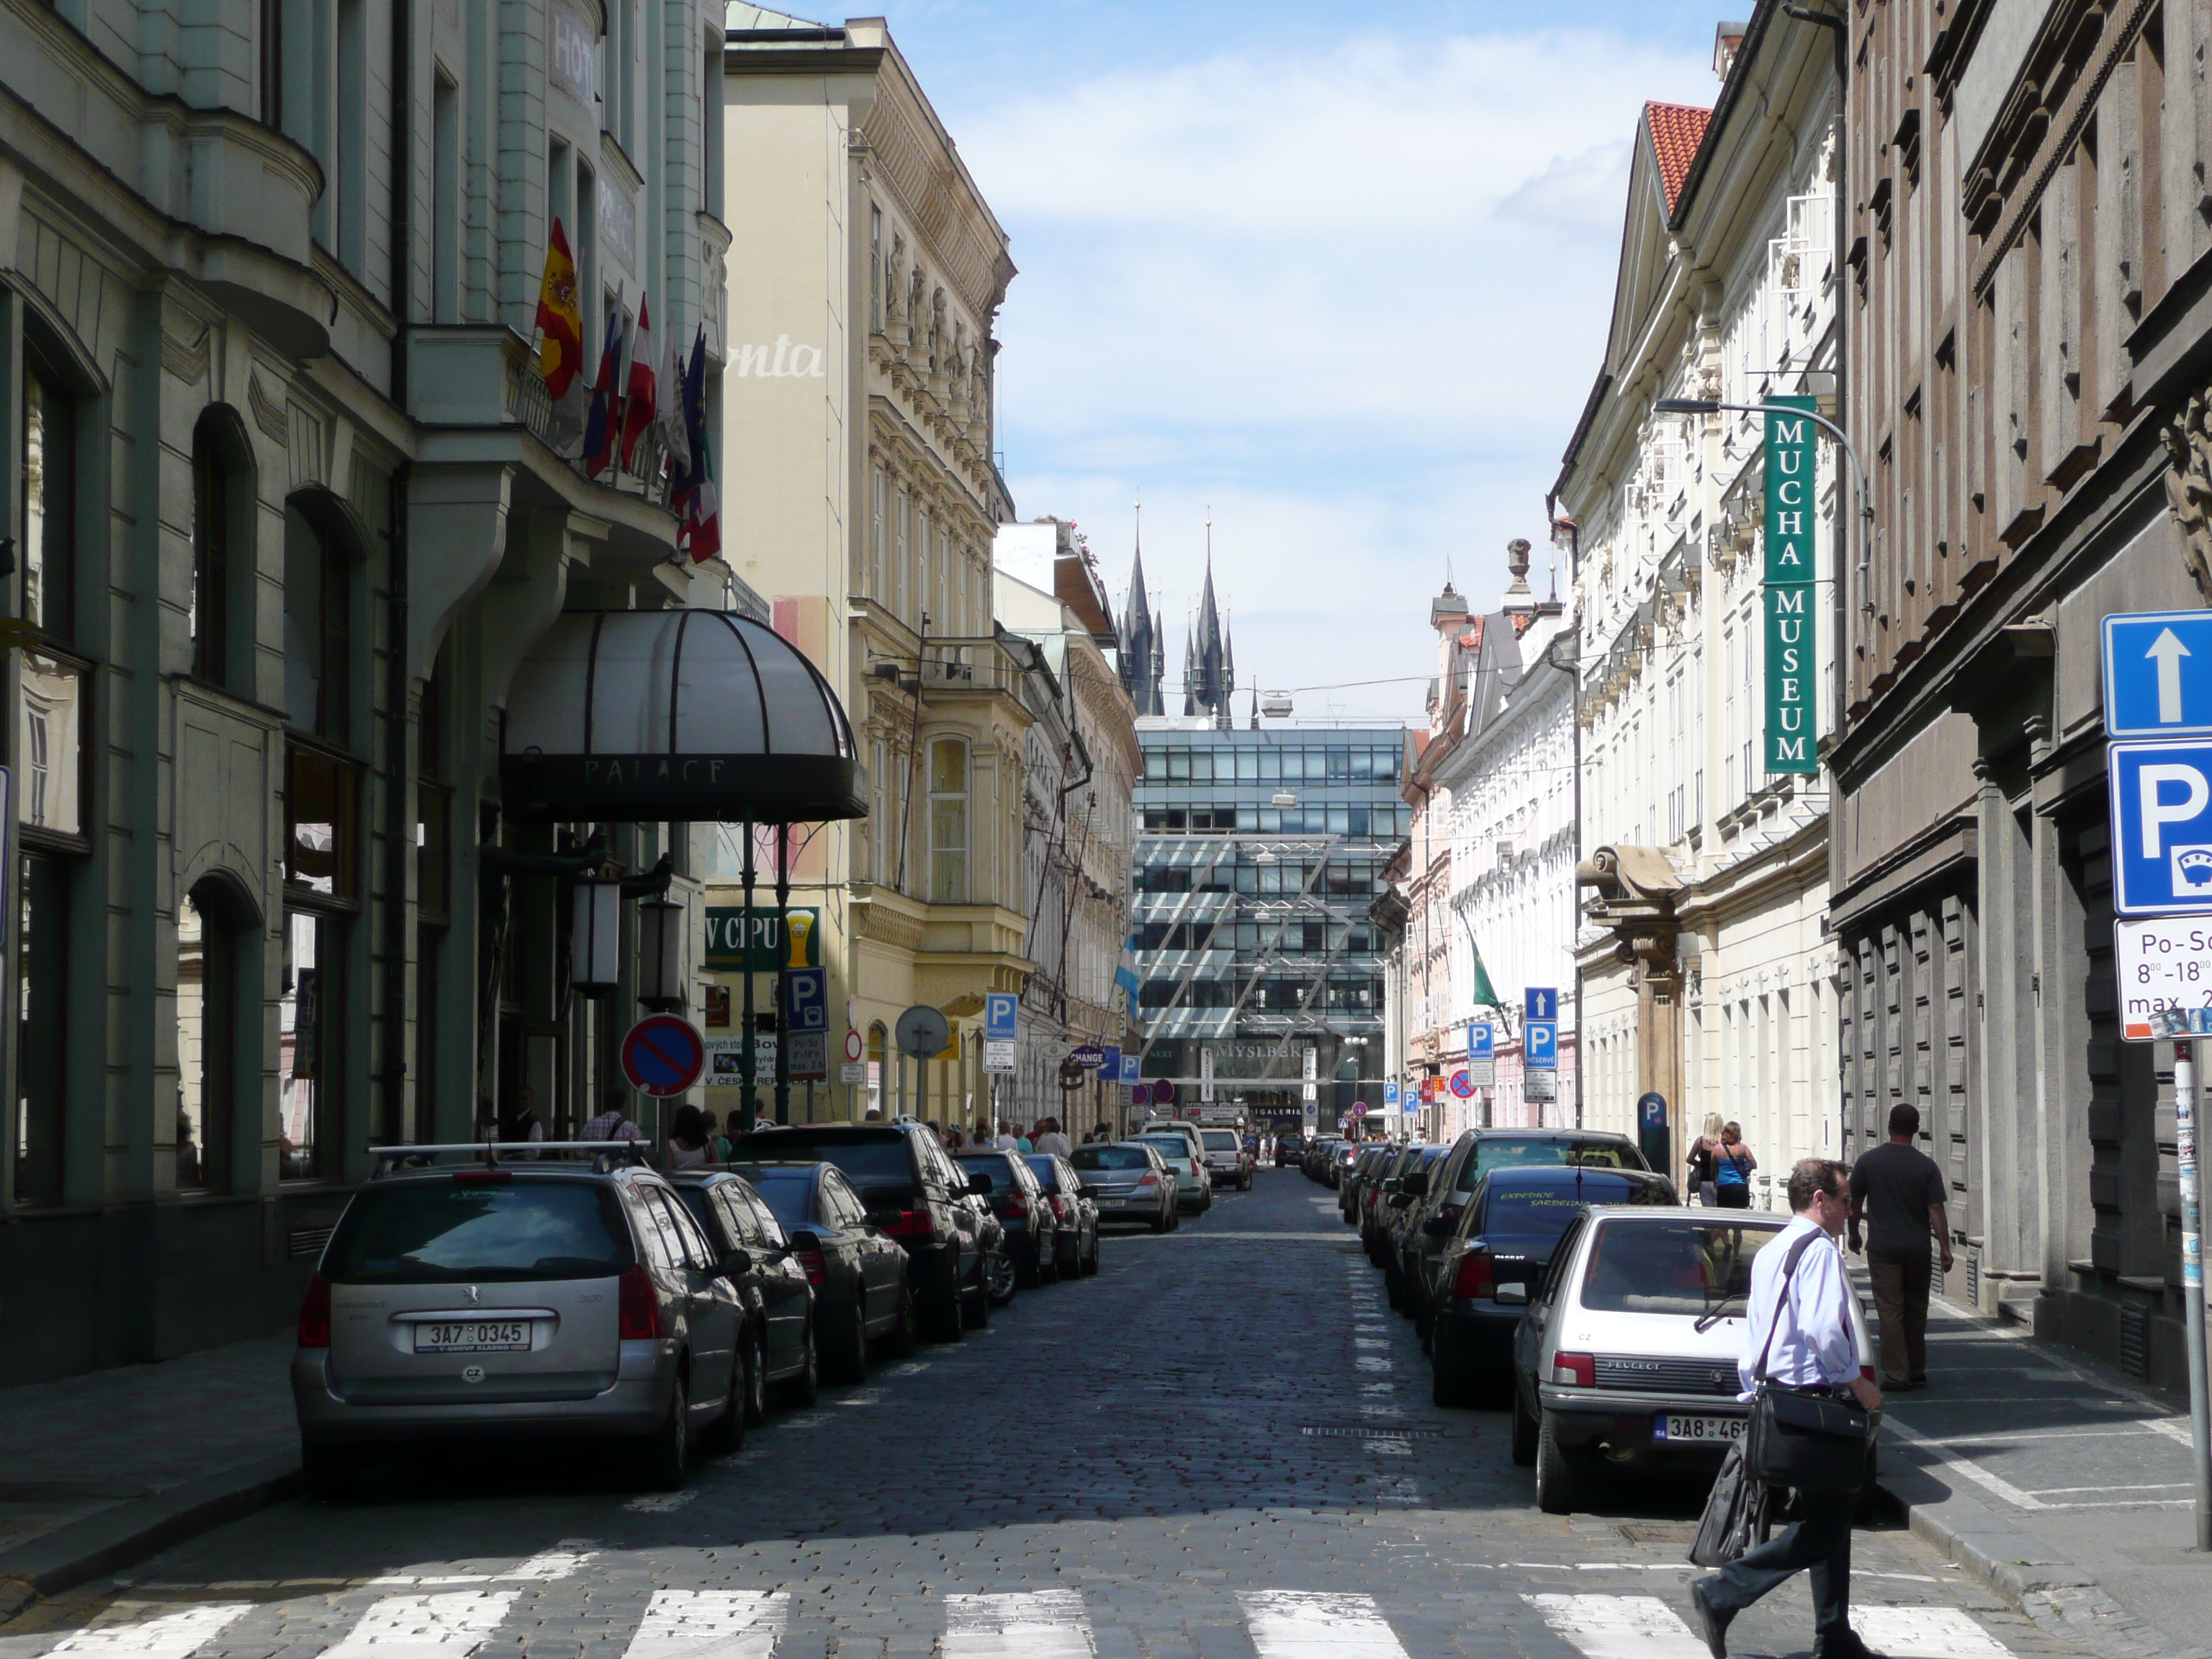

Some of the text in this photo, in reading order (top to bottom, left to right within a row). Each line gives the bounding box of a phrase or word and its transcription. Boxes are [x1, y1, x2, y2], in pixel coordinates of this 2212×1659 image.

[1775, 421, 1807, 760] MUCHA MUSEUM
[2139, 763, 2209, 858] P
[705, 917, 719, 949] V
[724, 909, 779, 949] CÍPU
[792, 976, 817, 1012] P
[992, 999, 1011, 1025] P
[1473, 1026, 1488, 1048] P
[1531, 1027, 1550, 1054] P
[1070, 1053, 1103, 1063] CHANGE
[1215, 1046, 1303, 1058] MYSLBEK
[1125, 1058, 1136, 1074] P
[1387, 1085, 1395, 1097] P
[1406, 1093, 1415, 1106] P
[1646, 1102, 1659, 1120] P
[431, 1323, 522, 1344] 3A7 0345
[1608, 1361, 1660, 1370] PEUGEOT
[1671, 1419, 1704, 1438] 3A8
